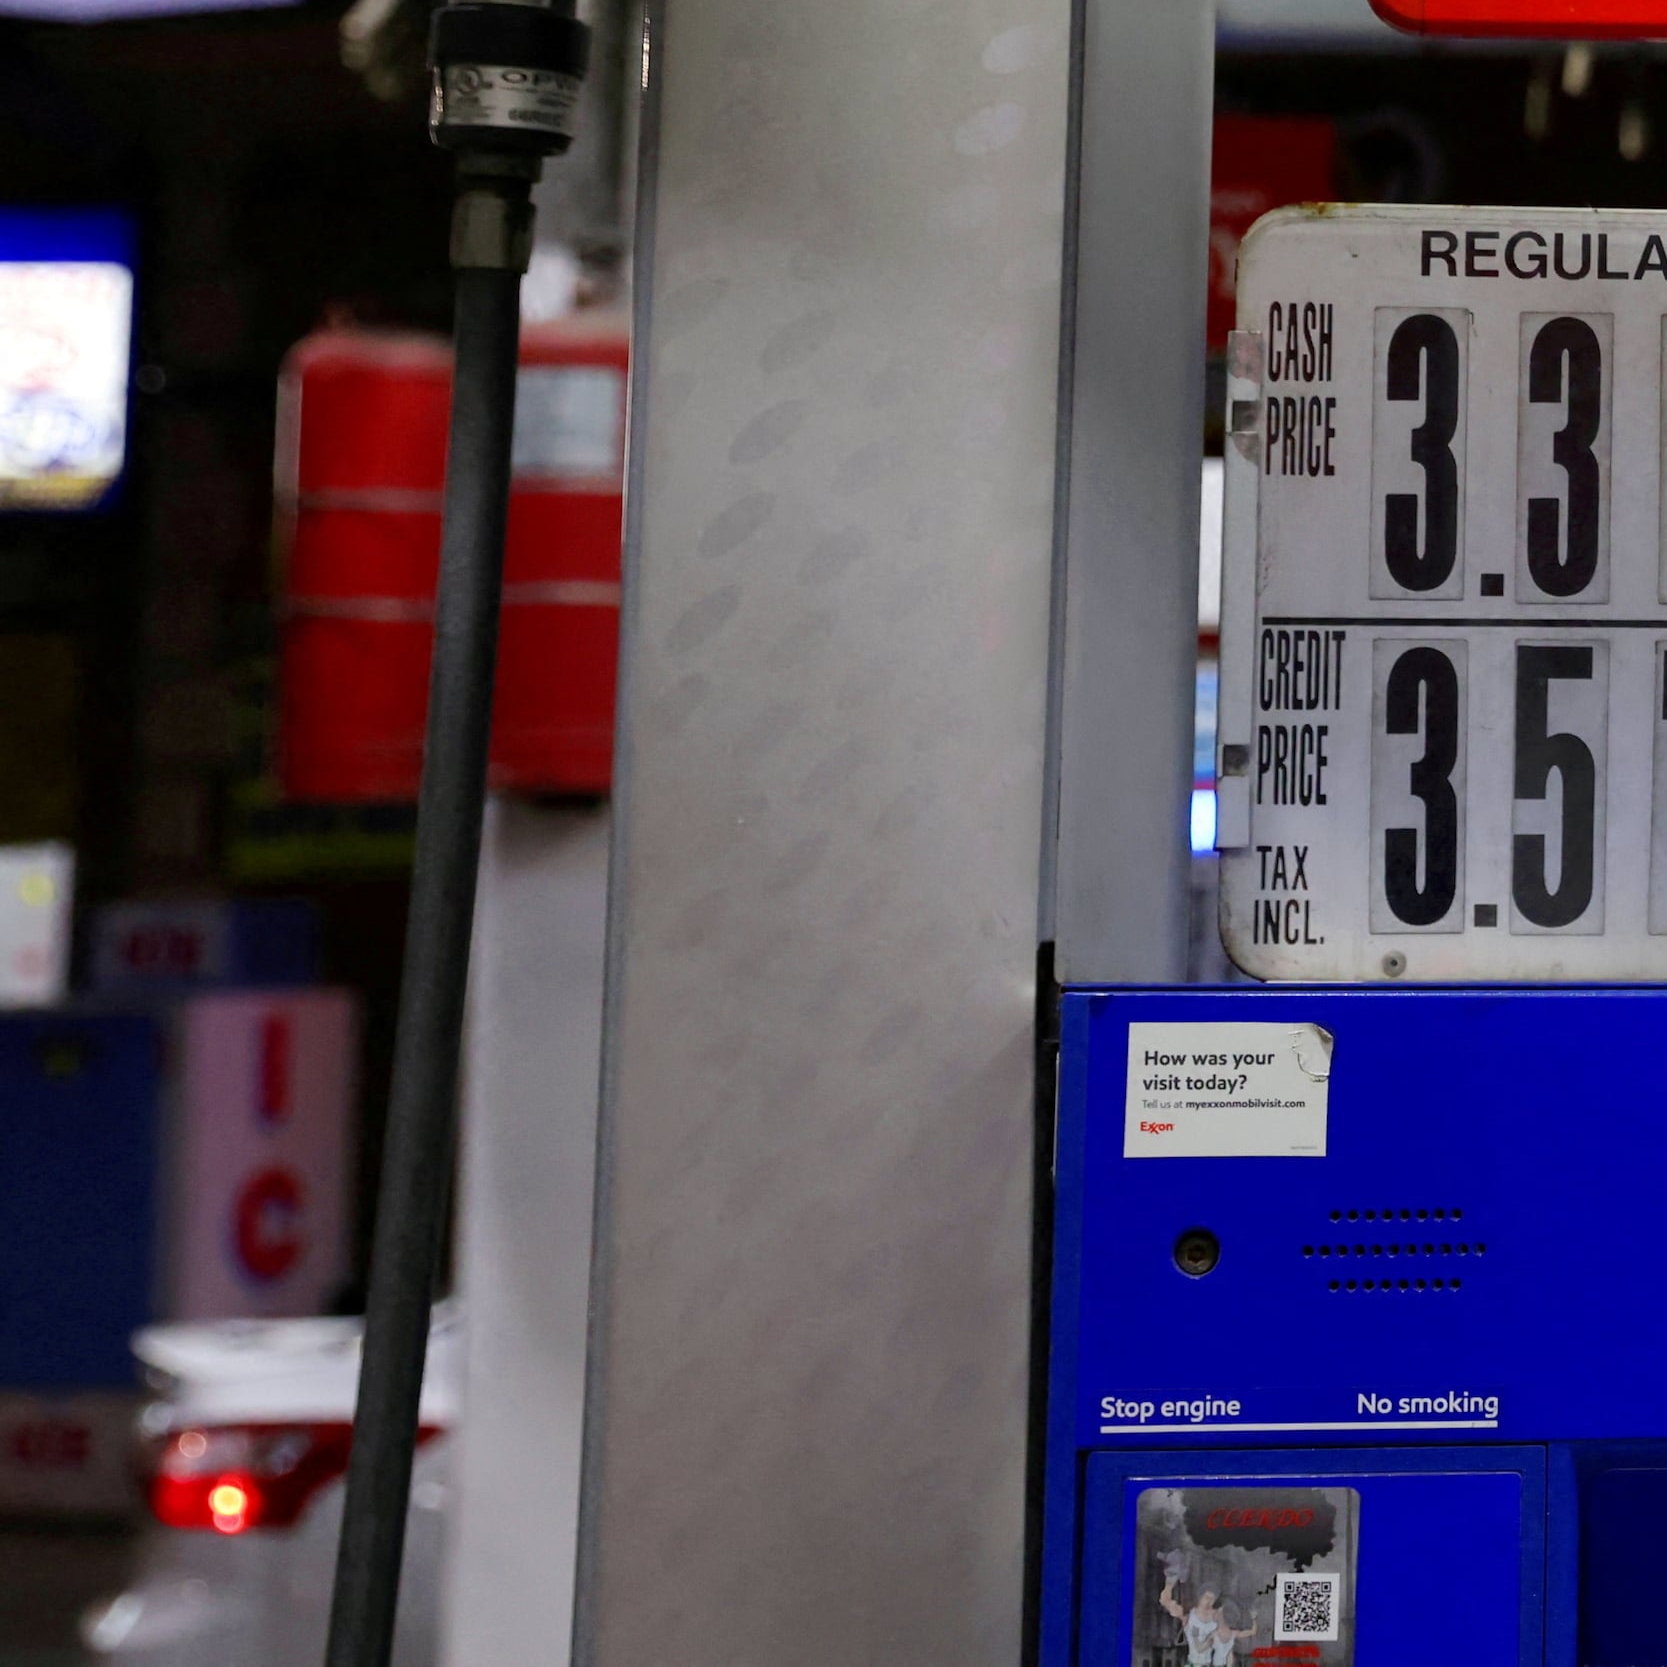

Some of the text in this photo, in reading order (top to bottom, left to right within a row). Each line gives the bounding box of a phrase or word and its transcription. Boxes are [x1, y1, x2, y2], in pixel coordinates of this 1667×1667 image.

[1269, 302, 1332, 382] CASH
[1267, 397, 1335, 476] PRICE
[1260, 629, 1345, 710] CREDIT
[1257, 724, 1328, 806] PRICE
[1256, 846, 1307, 890] TAX
[1253, 900, 1323, 944] INCL.
[1145, 1051, 1275, 1069] How was your
[1143, 1074, 1247, 1094] visit today?
[1142, 1100, 1157, 1108] Tell
[1186, 1099, 1305, 1110] myexxonmobilvisit.com
[1141, 1122, 1173, 1134] Exxon
[1101, 1395, 1240, 1423] Stop engine
[1358, 1391, 1498, 1422] No smoking
